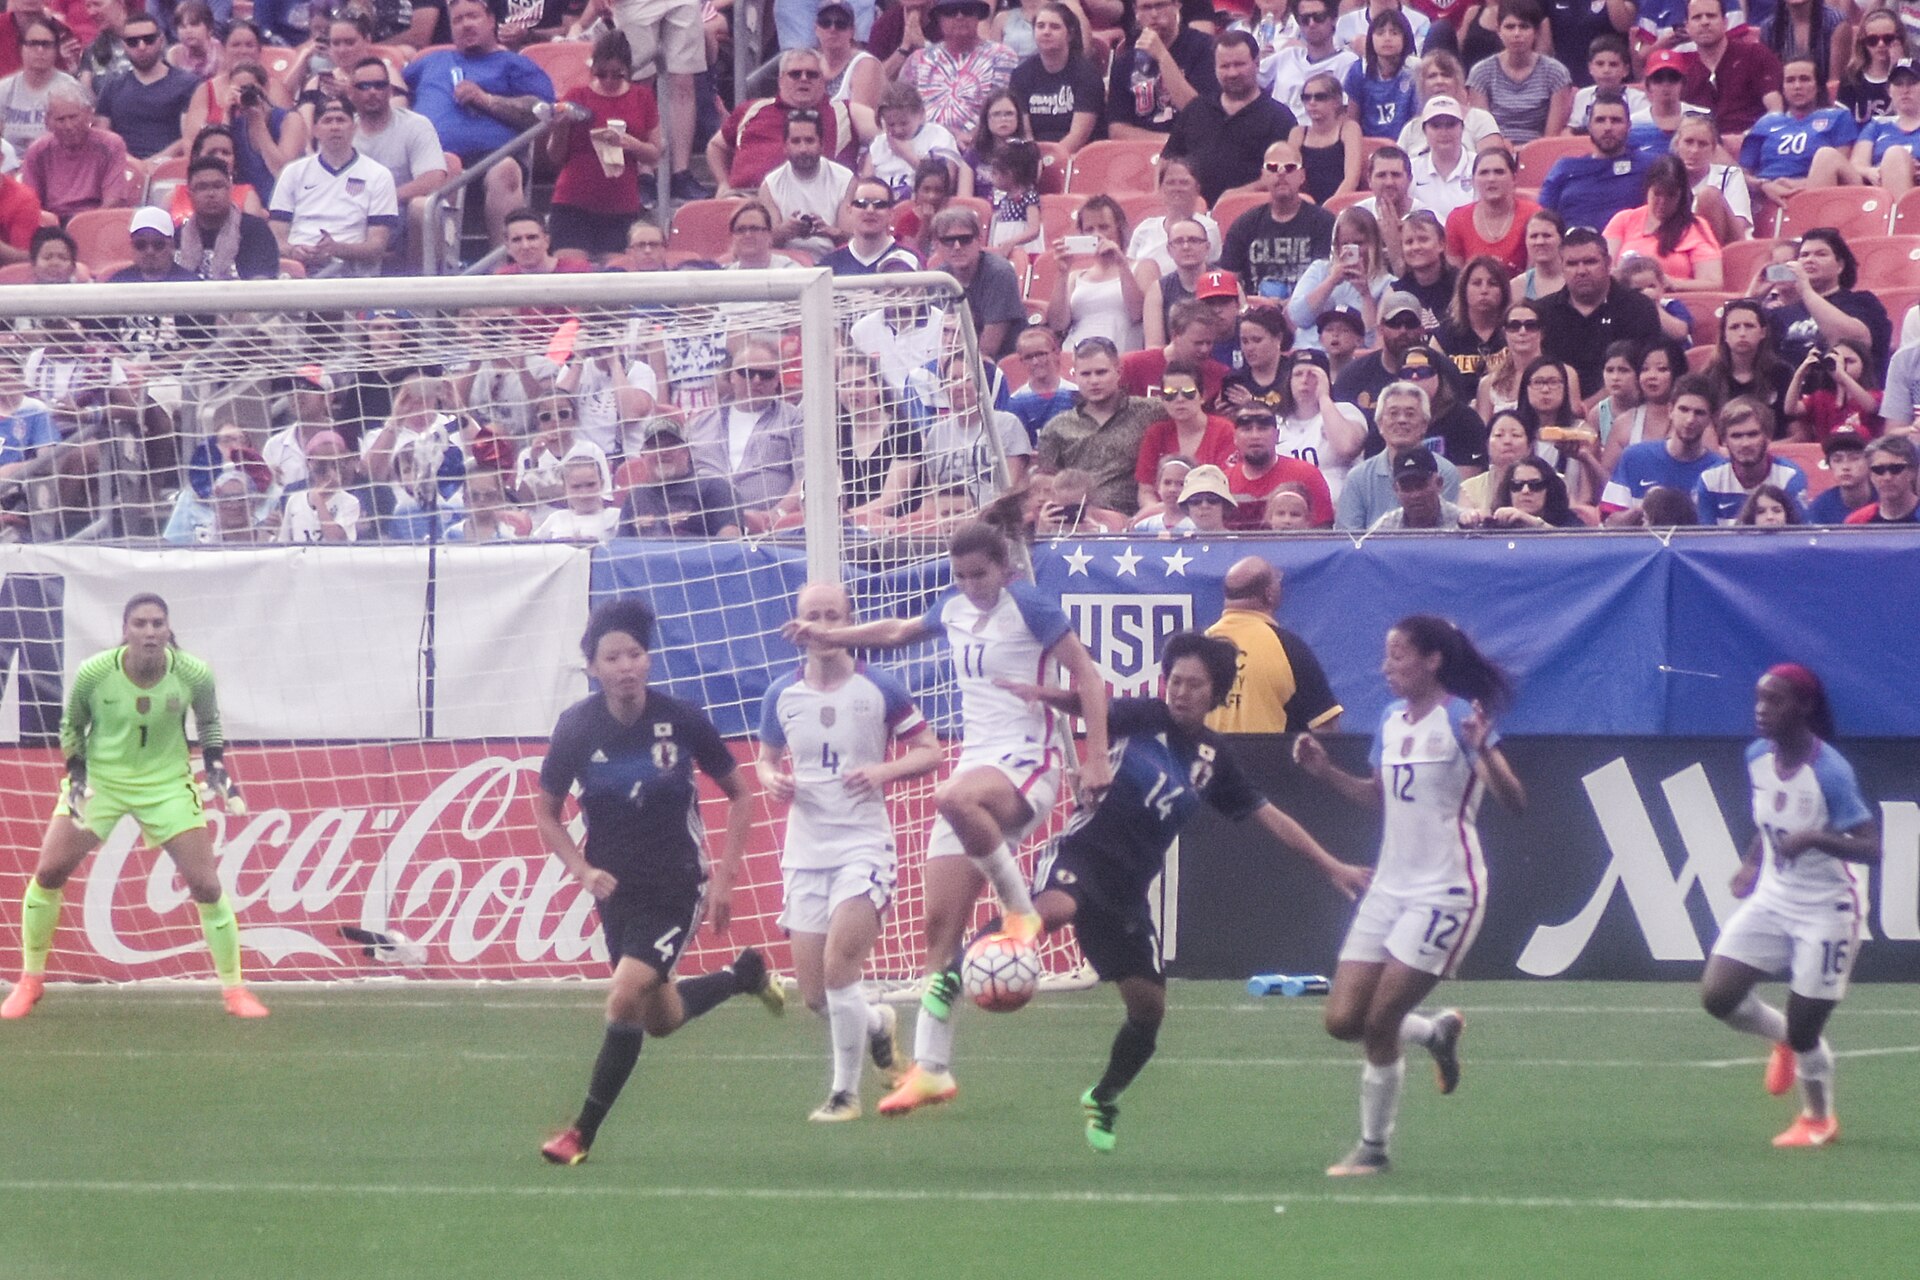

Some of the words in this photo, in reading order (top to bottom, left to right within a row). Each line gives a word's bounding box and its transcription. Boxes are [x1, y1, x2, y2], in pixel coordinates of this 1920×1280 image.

[1376, 103, 1396, 124] 13
[1778, 132, 1808, 155] 20
[1208, 272, 1222, 287] T
[138, 725, 148, 748] 1
[822, 742, 840, 774] 4
[1144, 771, 1185, 820] 14
[1392, 763, 1416, 802] 12
[653, 926, 682, 962] 4
[1424, 906, 1461, 951] 12
[1822, 940, 1848, 976] 16
